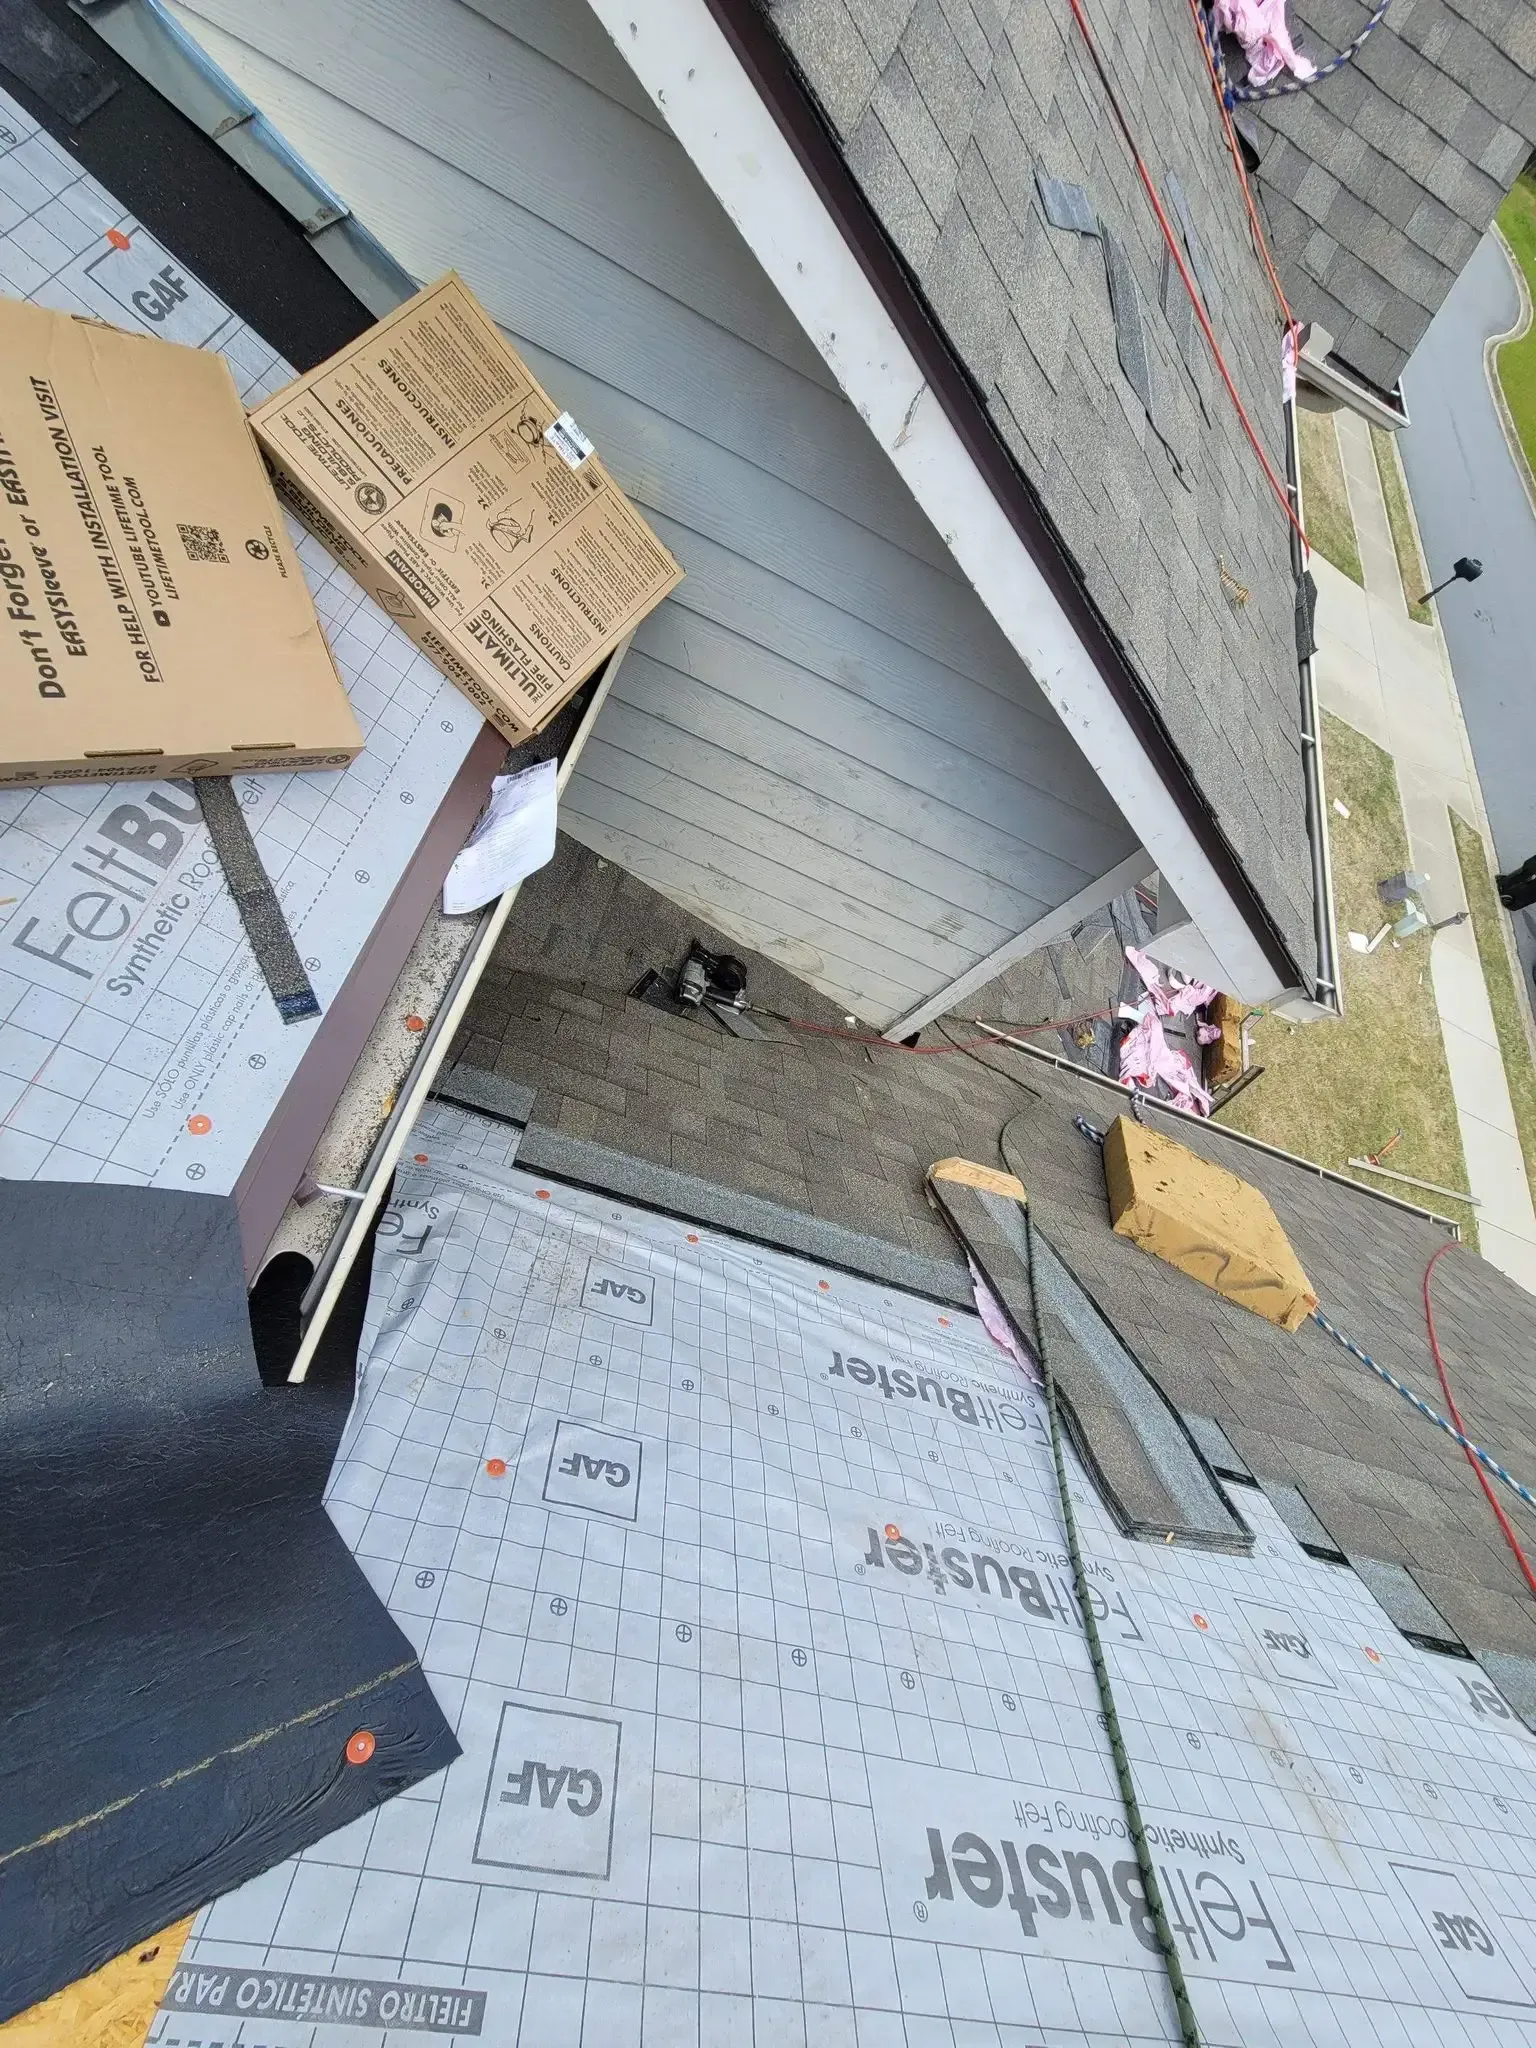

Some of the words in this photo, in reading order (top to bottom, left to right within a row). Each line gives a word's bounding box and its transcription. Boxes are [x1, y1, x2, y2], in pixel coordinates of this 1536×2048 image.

[132, 265, 189, 321] GAF
[29, 376, 60, 421] VISIT
[376, 357, 456, 449] INSTRUCCIONES
[278, 412, 309, 444] TOOL
[334, 397, 413, 485] PRECAUCIONES
[0, 431, 31, 506] EASY
[92, 445, 115, 482] TOOL
[300, 425, 348, 478] BUILDING
[306, 421, 362, 483] PRODUCTS
[306, 442, 351, 491] LIFETIME
[48, 427, 110, 550] INSTALLATION
[19, 514, 40, 536] or
[112, 483, 139, 543] LIFETIME
[386, 520, 400, 536] With
[122, 477, 180, 600] LIFETIMETOOL.COM
[263, 525, 280, 556] RECYCLE
[398, 534, 421, 560] Combine
[98, 554, 127, 600] WITH
[130, 546, 163, 607] YOUTUBE
[271, 555, 288, 578] PLEASE
[386, 550, 438, 606] IMPORTANT
[408, 555, 420, 568] ABS
[422, 571, 435, 585] PVC
[432, 573, 448, 591] Other
[432, 583, 446, 598] With
[446, 589, 457, 601] ALL
[548, 566, 608, 636] INSTRUCTIONS
[117, 604, 146, 646] HELP
[478, 606, 533, 666] FLASHING
[19, 627, 66, 698] Don't
[143, 648, 160, 683] FOR
[464, 616, 540, 698] ULTIMATE
[527, 622, 572, 672] CAUTIONS
[418, 634, 487, 707] 877-904-1002
[423, 629, 521, 734] LIFETIMETOOL.COM
[528, 663, 554, 691] PIPE
[529, 690, 544, 704] THE
[12, 777, 204, 980] FeltBu
[107, 893, 190, 996] Synthetic
[178, 836, 222, 893] Roof
[172, 1092, 186, 1111] Use
[183, 1058, 209, 1095] ONLY
[221, 1009, 239, 1034] cap
[231, 987, 249, 1014] nails
[142, 1099, 159, 1119] Use
[154, 1067, 181, 1101] SÓLO
[388, 1199, 440, 1220] Synth
[590, 1277, 647, 1305] GAF
[914, 1356, 972, 1386] Roofing
[976, 1379, 1036, 1409] Synthetic
[558, 1452, 631, 1488] GAF
[935, 1521, 965, 1538] Felt
[970, 1527, 1032, 1564] Roofing
[1034, 1544, 1115, 1583] Synetic
[1263, 1629, 1313, 1659] GAF
[499, 1760, 604, 1818] GAF
[1014, 1799, 1050, 1827] Felt
[1143, 1823, 1246, 1865] Synthetic
[1432, 1909, 1495, 1957] GAF
[237, 1977, 368, 2021] SINTÉTICO
[379, 1987, 474, 2028] FIELTRO
